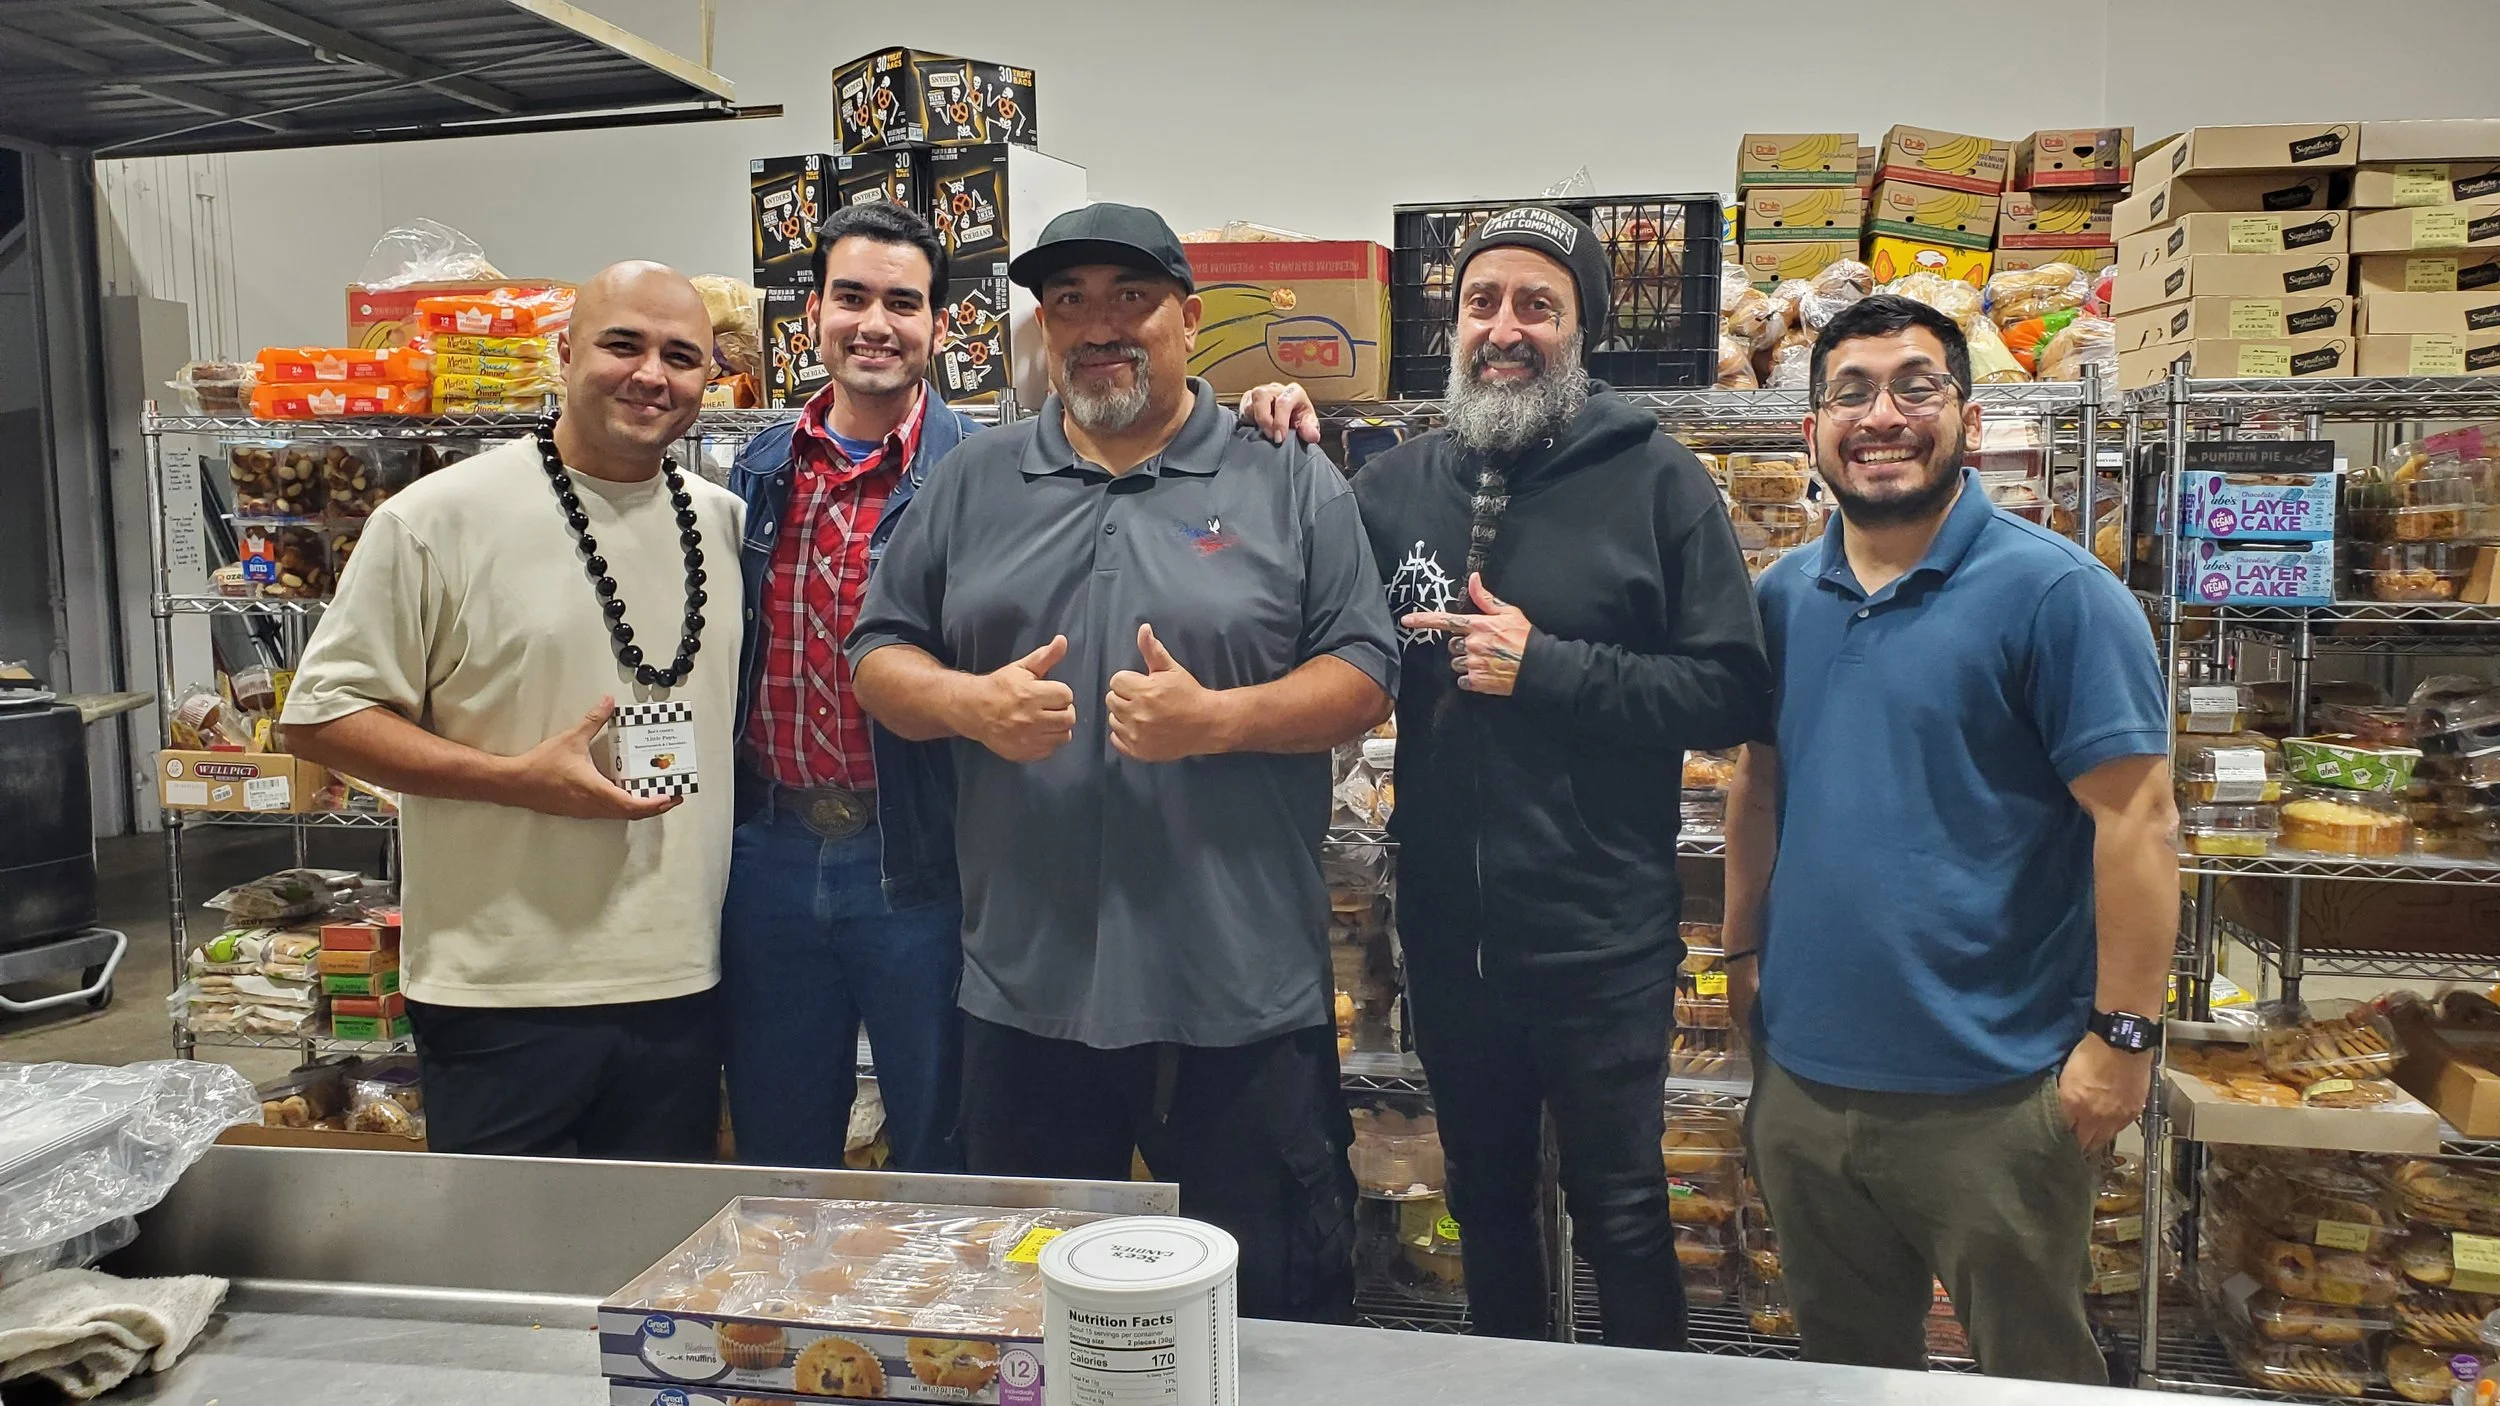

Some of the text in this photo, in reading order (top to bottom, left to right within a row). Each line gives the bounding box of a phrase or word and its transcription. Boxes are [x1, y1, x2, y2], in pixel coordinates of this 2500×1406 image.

[876, 55, 886, 73] 30
[999, 66, 1013, 82] 30
[1013, 70, 1032, 79] TREAT
[1013, 77, 1032, 87] BAGS
[1756, 145, 1777, 155] Dole
[1904, 138, 1926, 150] Dole
[2295, 140, 2333, 156] Signature
[805, 155, 819, 171] 30
[895, 152, 910, 168] 30
[1530, 208, 1574, 236] MARKET
[1493, 219, 1566, 241] ART COMPANY
[1211, 261, 1255, 274] PREMIUM
[1316, 260, 1360, 273] PREMIUM
[2289, 272, 2325, 285] Signature
[2292, 313, 2329, 328] Signature
[447, 335, 472, 349] Martin's
[1278, 340, 1339, 368] Dole
[446, 356, 510, 371] Martin's Sweet
[2295, 355, 2331, 369] Signature
[292, 366, 302, 374] 24
[801, 366, 827, 380] NYDER'S
[443, 375, 505, 391] Martin's Sweet
[475, 389, 502, 397] Dinner
[2201, 451, 2281, 463] PUMPKIN PIE
[2241, 500, 2310, 516] LAYER
[2210, 515, 2234, 528] VEGAN
[2241, 516, 2302, 531] CAKE
[2237, 565, 2308, 581] LAYER
[2203, 582, 2228, 593] VEGAN
[2235, 582, 2299, 597] CAKE
[199, 765, 255, 776] WELLPICT
[647, 1319, 670, 1330] Great
[1069, 1309, 1173, 1328] Nutrition Facts
[653, 1327, 671, 1335] Value
[1069, 1325, 1084, 1334] About
[1094, 1329, 1119, 1339] servings
[1134, 1330, 1164, 1338] container
[1069, 1331, 1104, 1345] Serving size
[1134, 1339, 1156, 1347] pieces
[1158, 1336, 1175, 1345] (30g)
[686, 1354, 717, 1364] Muffins
[1070, 1351, 1175, 1367] Calories 170
[1009, 1361, 1030, 1378] 12
[660, 1393, 683, 1403] Great
